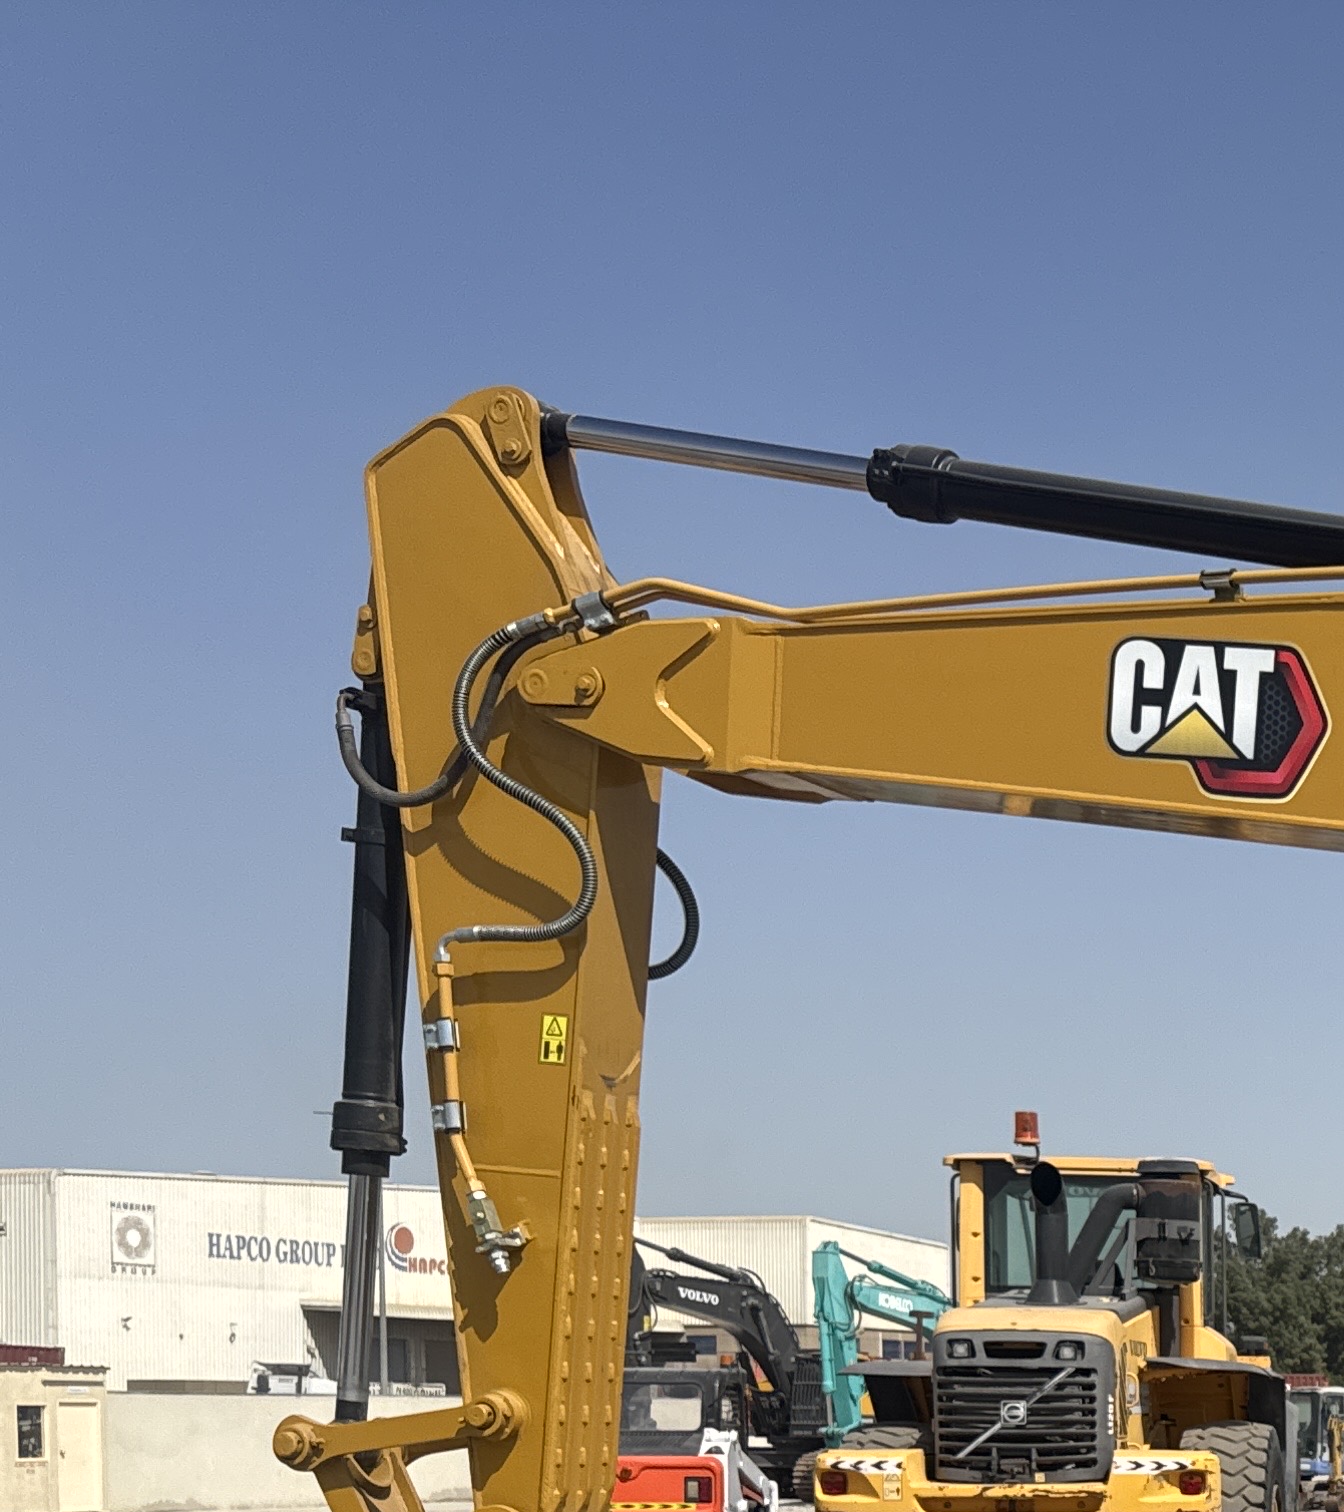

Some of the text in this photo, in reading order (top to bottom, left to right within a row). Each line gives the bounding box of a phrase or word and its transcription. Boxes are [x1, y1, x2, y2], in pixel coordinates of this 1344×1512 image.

[1110, 638, 1276, 761] CAT
[207, 1232, 271, 1262] HAPCO
[275, 1238, 336, 1267] GROUP
[408, 1256, 450, 1275] HAPC
[677, 1286, 720, 1306] VOLVO
